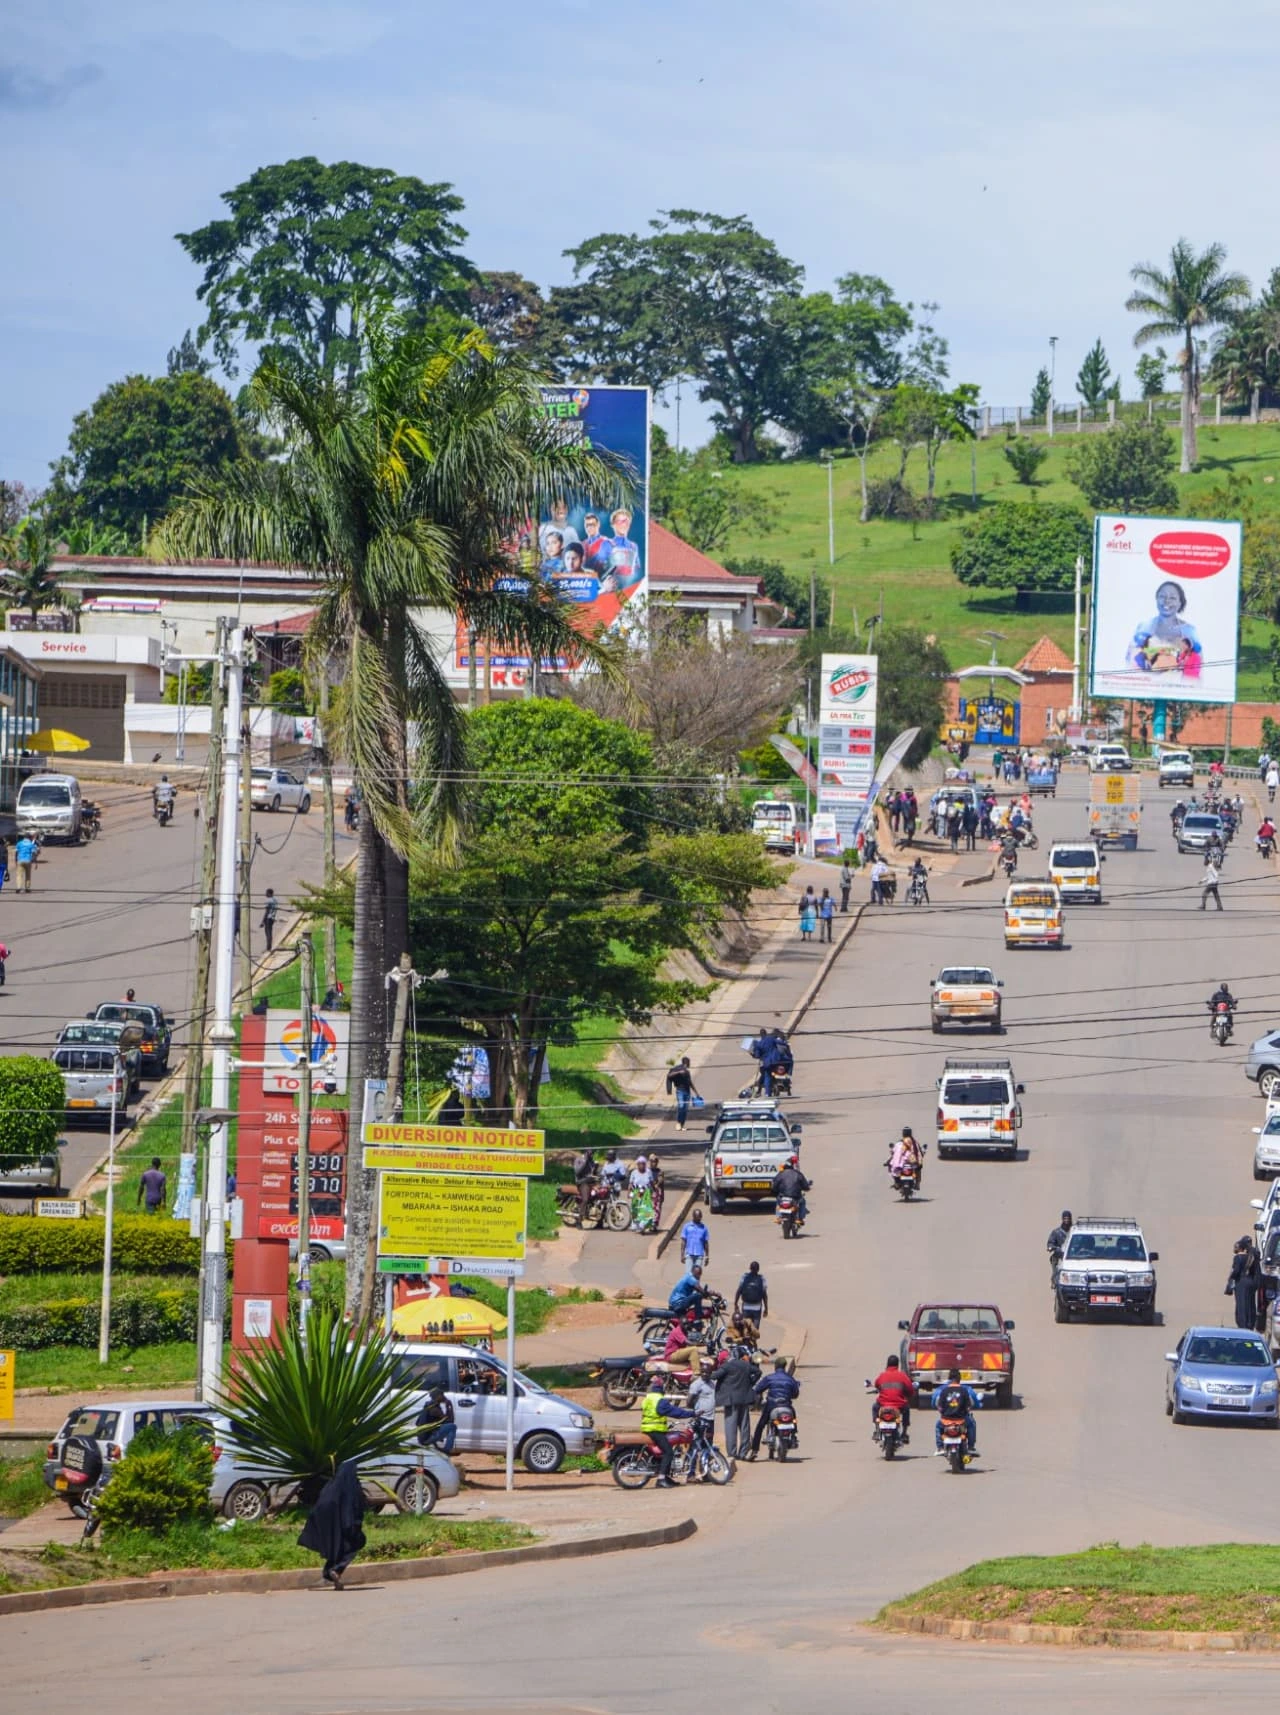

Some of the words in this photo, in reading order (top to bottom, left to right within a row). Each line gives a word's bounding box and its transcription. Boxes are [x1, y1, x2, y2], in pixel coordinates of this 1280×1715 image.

[1106, 540, 1132, 550] airtel
[42, 641, 87, 654] Service
[833, 671, 866, 693] RUBIS
[265, 1112, 287, 1123] 24h
[290, 1113, 333, 1124] Sevice
[263, 1135, 284, 1145] Plus
[373, 1126, 468, 1143] DIVERSION
[472, 1131, 537, 1147] NOTICE
[419, 1151, 466, 1161] CHANNEL
[415, 1160, 452, 1169] BRIDGE
[454, 1162, 494, 1172] CLOSED
[733, 1164, 777, 1174] TOYOTA
[386, 1176, 420, 1185] Alternative
[421, 1176, 440, 1185] Route
[444, 1178, 465, 1187] Detour
[475, 1179, 495, 1189] Heavy
[496, 1180, 522, 1188] Vehicles
[386, 1190, 434, 1200] FORTPORTAL
[441, 1193, 485, 1202] KAMWENGE
[493, 1195, 521, 1203] IBANDA
[402, 1202, 441, 1210] MBARARA
[450, 1204, 480, 1212] ISHAKA
[481, 1205, 504, 1213] ROAD
[270, 1222, 331, 1237] exceium
